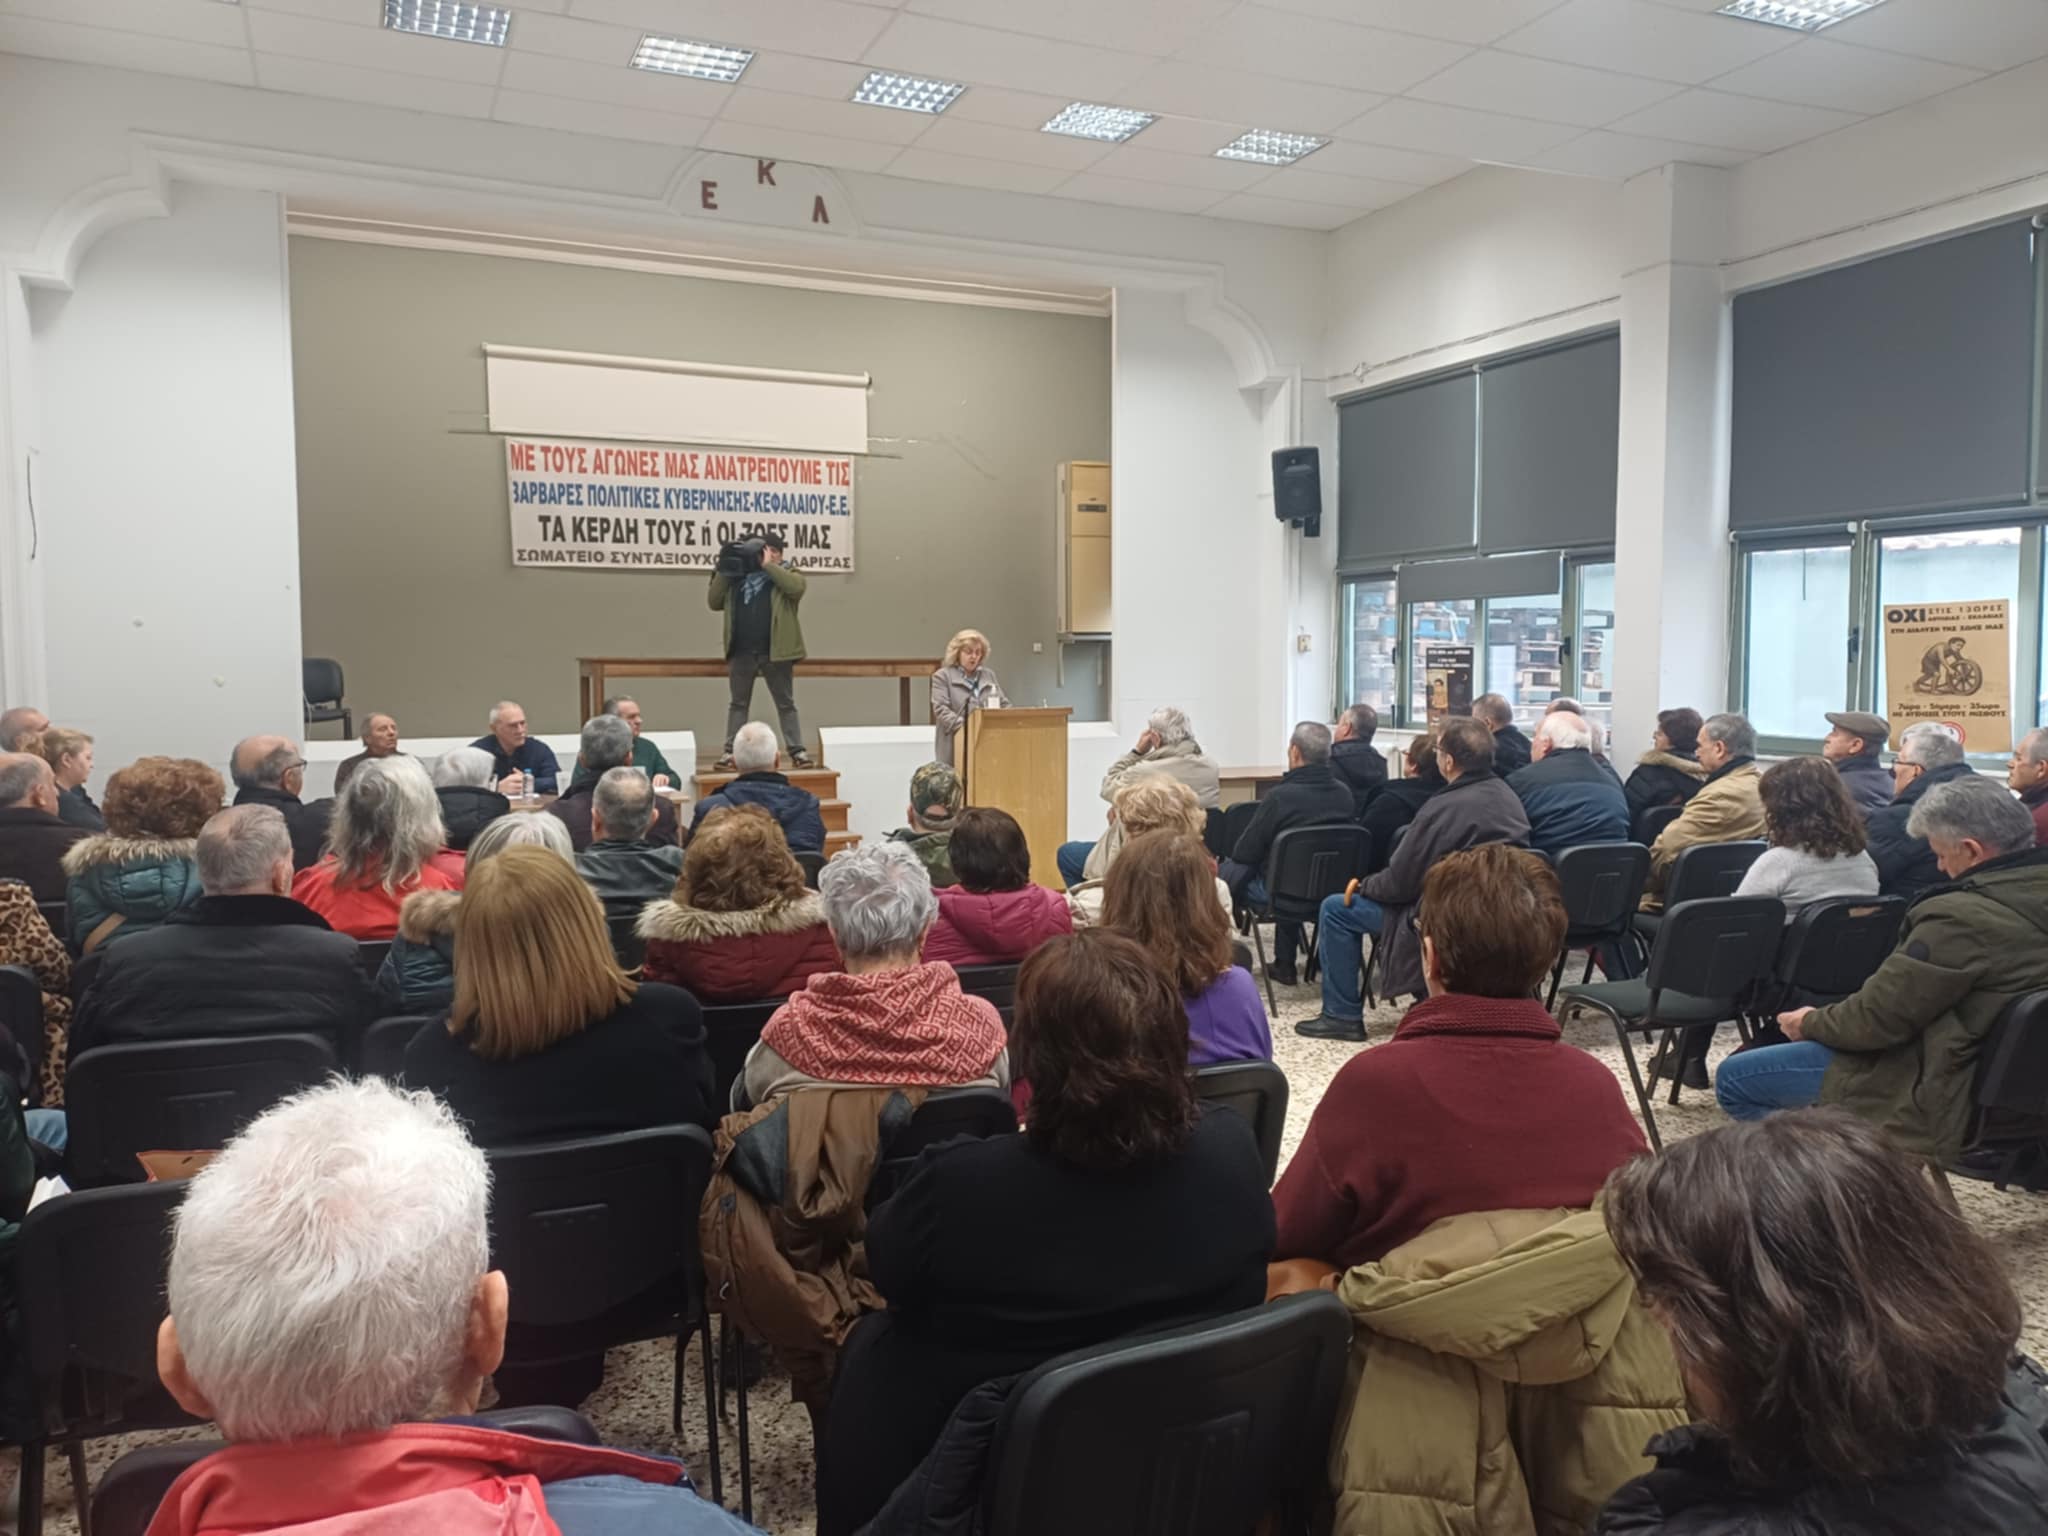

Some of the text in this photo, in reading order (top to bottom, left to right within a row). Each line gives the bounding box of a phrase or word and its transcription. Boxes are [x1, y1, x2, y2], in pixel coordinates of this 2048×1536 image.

[757, 159, 776, 186] Κ
[510, 443, 850, 486] ΜΕ ΤΟΥΣ ΑΓΩΝΕΣ ΜΑΣ ΑΝΑΤΡΕΠΟΥΜΕ ΤΙΣ
[587, 484, 660, 509] ΠΟΛΙΤΙΚΕΣ
[538, 515, 566, 542] ΤΑ
[572, 516, 639, 544] ΚΕΡΔΗ
[644, 518, 696, 547] ΤΟΥΣ
[701, 520, 711, 546] ή
[717, 521, 736, 546] ΟΙ
[794, 523, 831, 550] ΜΑΣ
[517, 549, 851, 569] ΣΩΜΑΤΕΙΟ ΣΥΝΤΑΞΙΟΥΧ ΛΑΡΙΣΑΣ
[1887, 608, 1926, 623] ΟΧΙ
